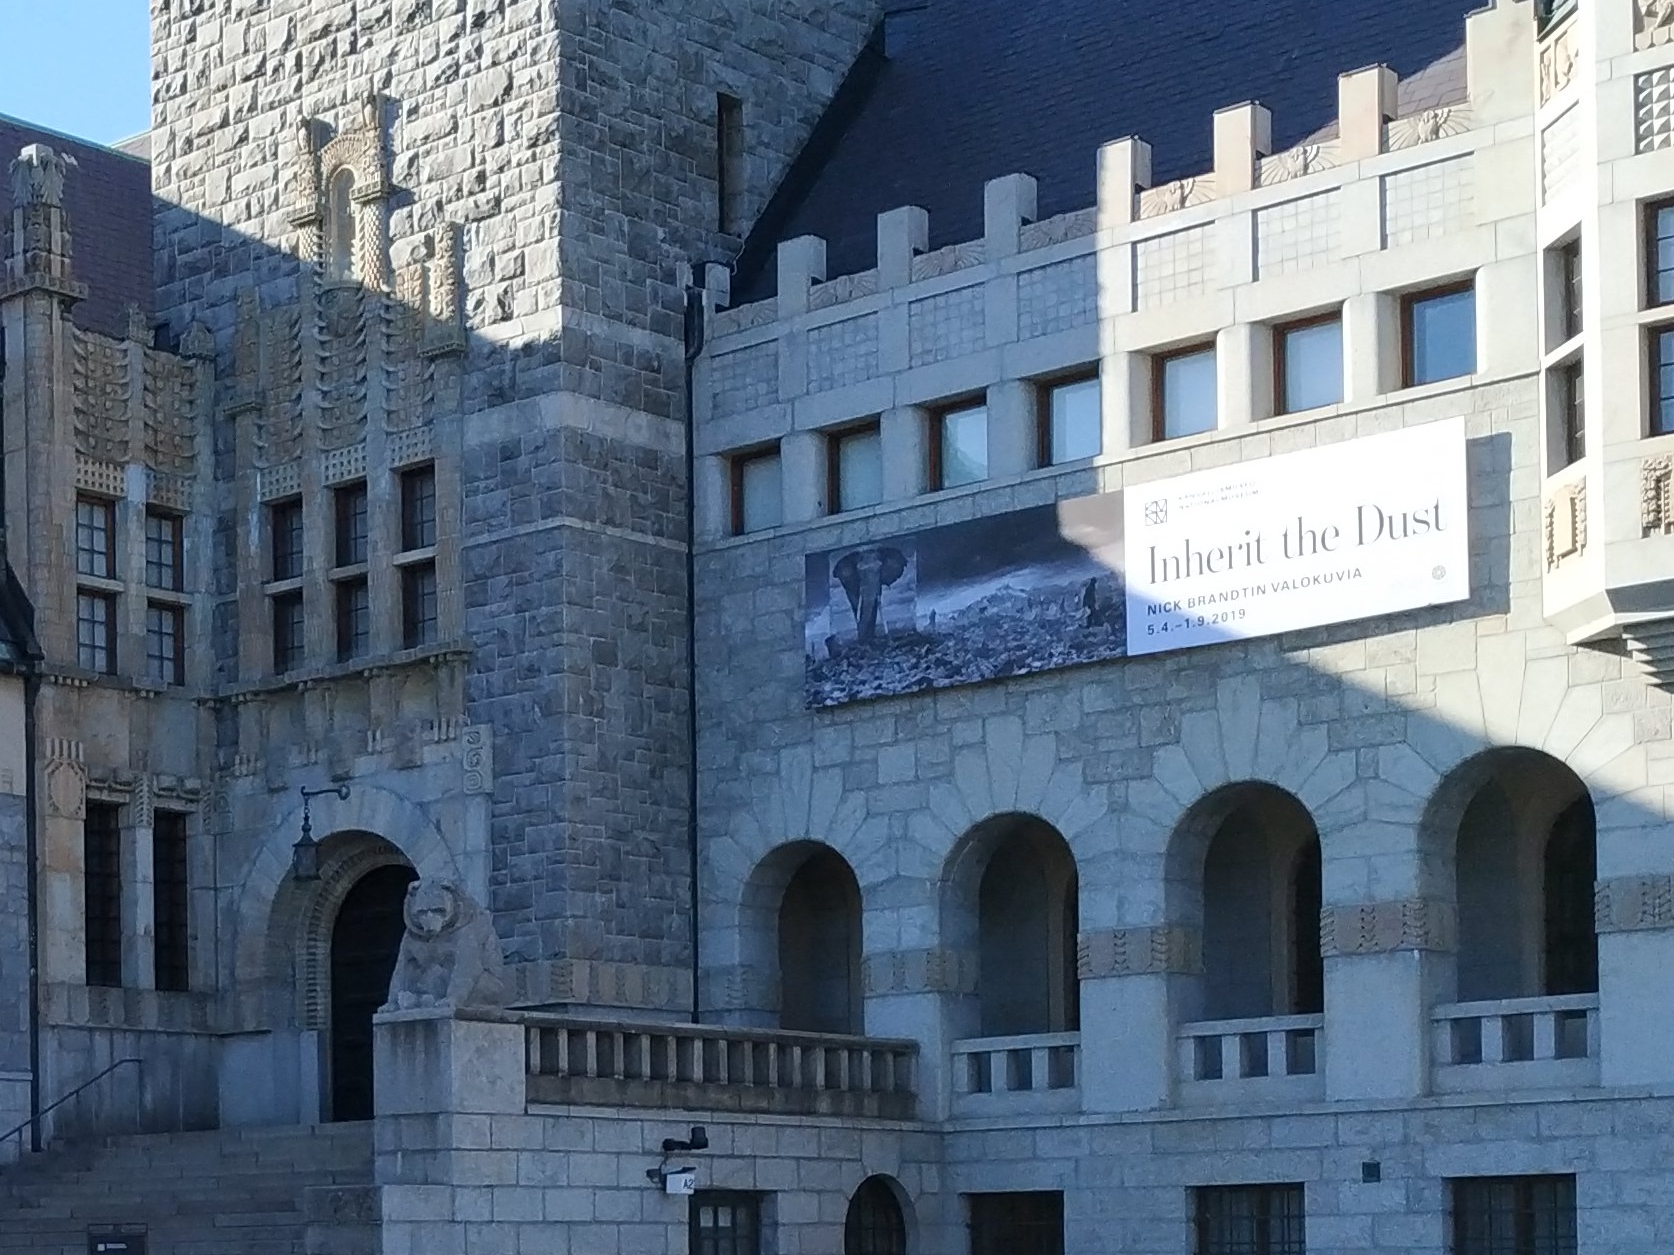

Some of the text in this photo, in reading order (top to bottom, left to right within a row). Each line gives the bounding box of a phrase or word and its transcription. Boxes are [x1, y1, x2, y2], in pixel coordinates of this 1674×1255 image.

[1148, 498, 1446, 585] Inherit the Dust
[1147, 567, 1363, 616] NICK BRANDTIN VALOKUVIA
